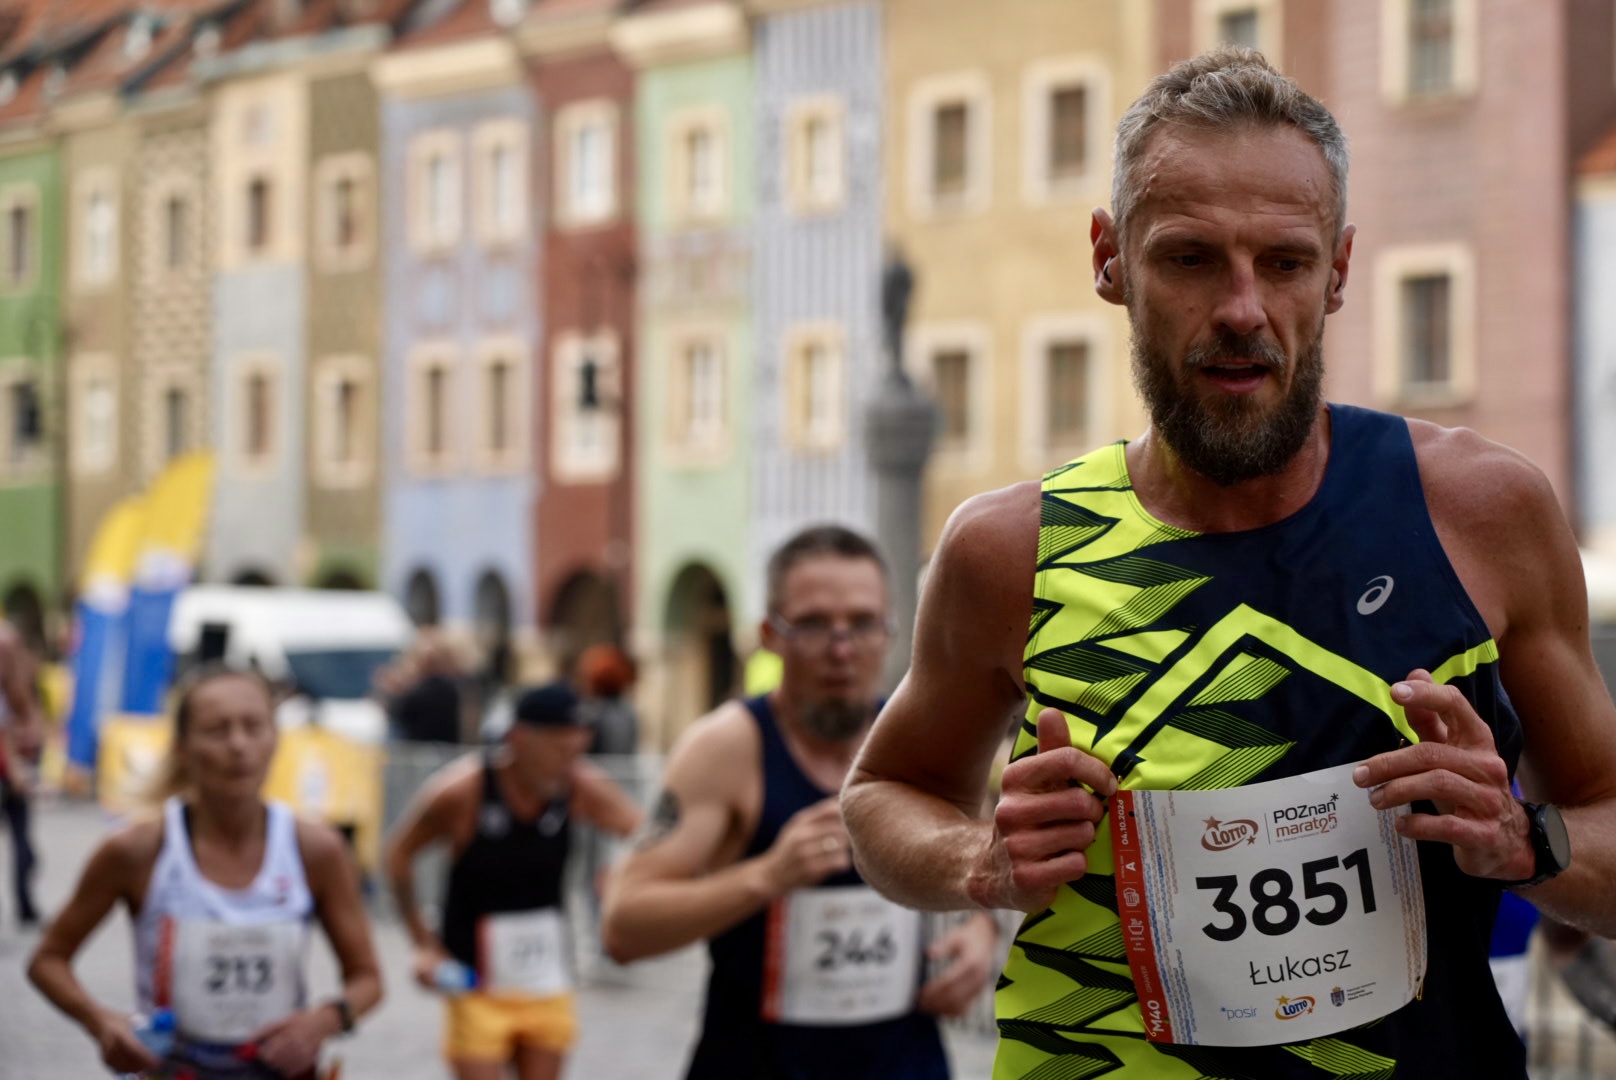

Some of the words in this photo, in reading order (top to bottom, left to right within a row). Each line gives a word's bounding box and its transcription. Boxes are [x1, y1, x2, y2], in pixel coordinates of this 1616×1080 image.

[1211, 825, 1247, 845] LOTTO
[1125, 861, 1136, 872] A
[1195, 848, 1377, 942] 3851
[205, 955, 274, 995] 213
[1249, 949, 1352, 985] Łukasz
[1147, 1000, 1165, 1032] M40
[1282, 1000, 1308, 1016] LOTTO
